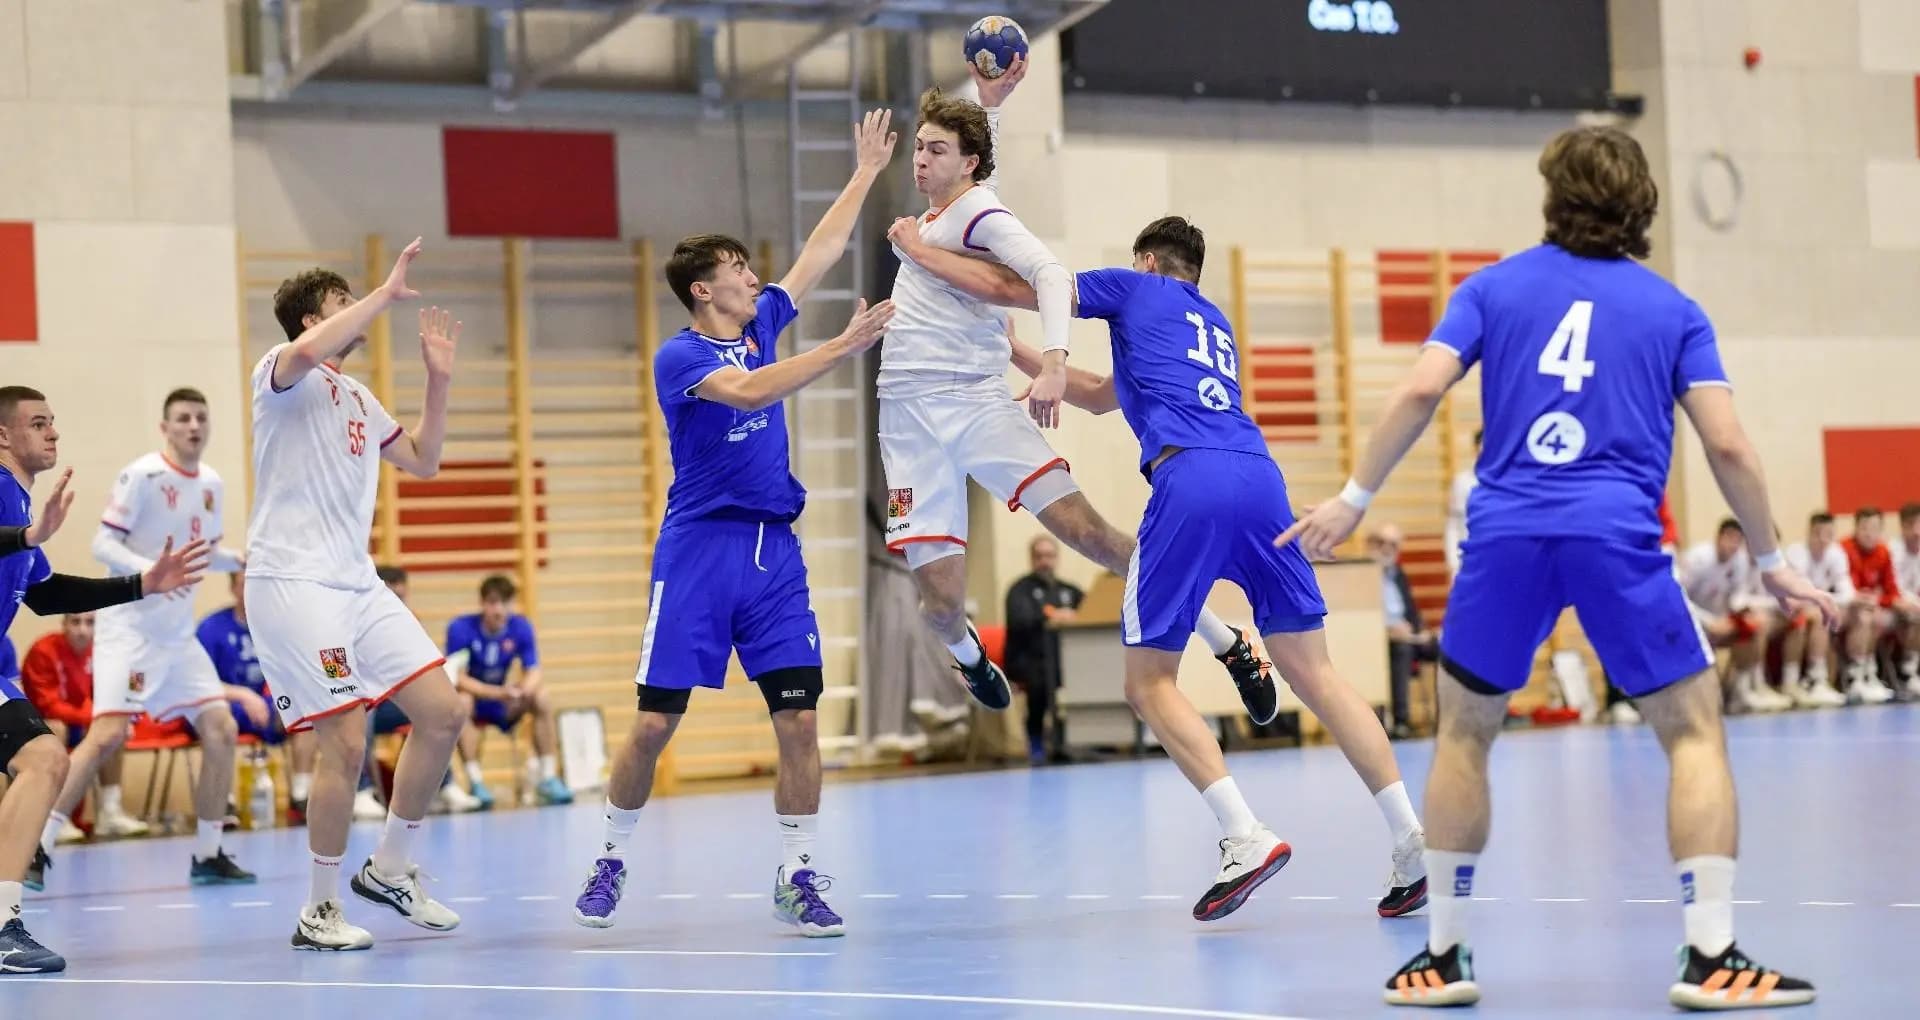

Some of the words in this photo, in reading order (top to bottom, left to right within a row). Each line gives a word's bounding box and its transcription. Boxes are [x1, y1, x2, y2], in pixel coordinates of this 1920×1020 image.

[1185, 311, 1237, 382] 15
[1537, 300, 1595, 392] 4
[348, 419, 366, 456] 55
